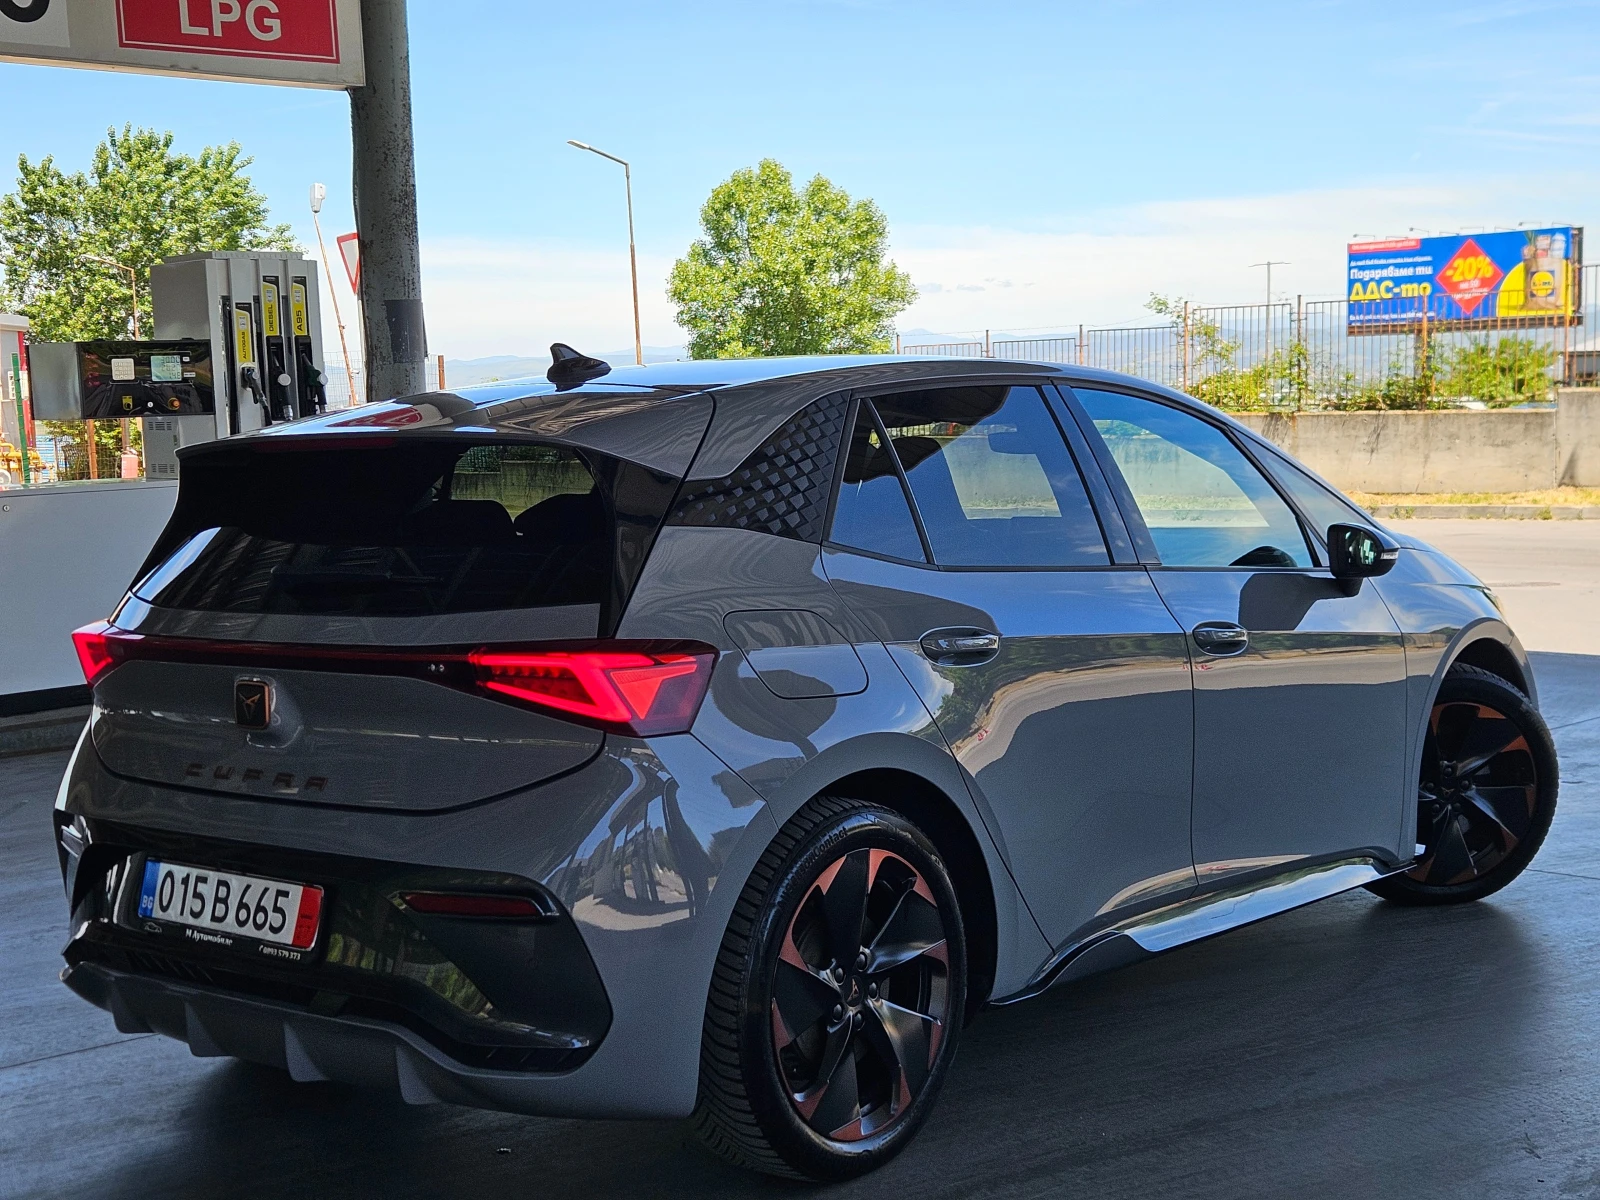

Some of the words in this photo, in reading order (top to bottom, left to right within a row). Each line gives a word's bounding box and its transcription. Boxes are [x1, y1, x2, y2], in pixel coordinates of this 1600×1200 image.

[180, 0, 282, 41] LPG
[1350, 265, 1414, 281] Подаряваме
[1446, 255, 1494, 283] -20%
[185, 763, 328, 791] CUPRA
[141, 895, 154, 909] BG
